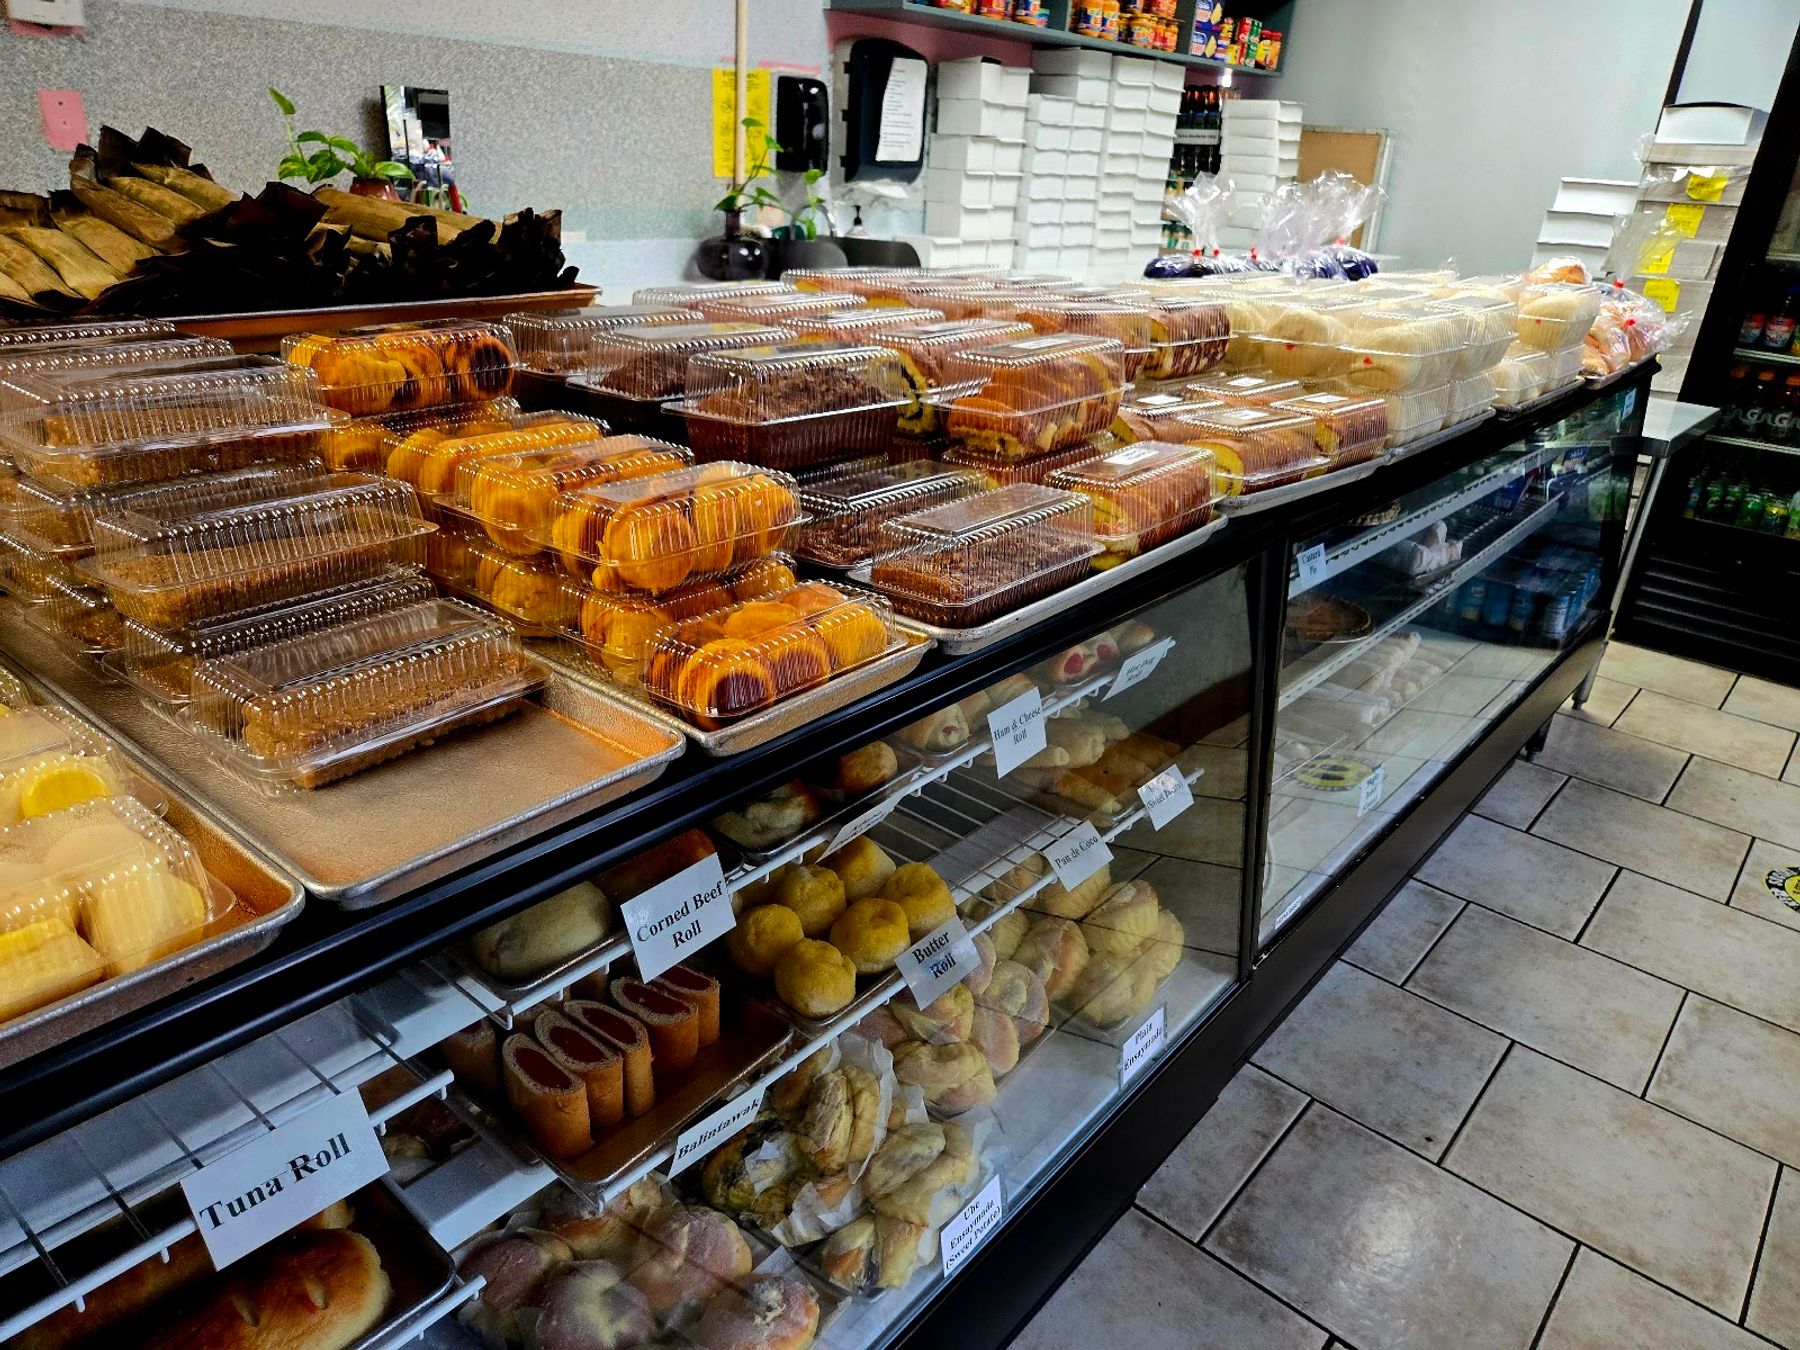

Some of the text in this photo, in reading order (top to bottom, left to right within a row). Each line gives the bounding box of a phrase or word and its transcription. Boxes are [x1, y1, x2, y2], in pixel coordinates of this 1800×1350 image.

[993, 707, 1041, 741] Ham & Cheese
[1013, 728, 1028, 745] Roll
[1054, 835, 1098, 870] Pan de Coco
[637, 881, 722, 941] Corned Beef
[672, 920, 702, 949] Roll
[912, 932, 950, 965] Butter
[929, 952, 957, 980] Roll
[678, 1099, 760, 1159] Balintawak
[199, 1132, 352, 1230] Tuna Roll
[950, 1200, 995, 1250] Ensaymada
[964, 1201, 980, 1220] Ube
[945, 1206, 1001, 1271] (Sweet Potato)
